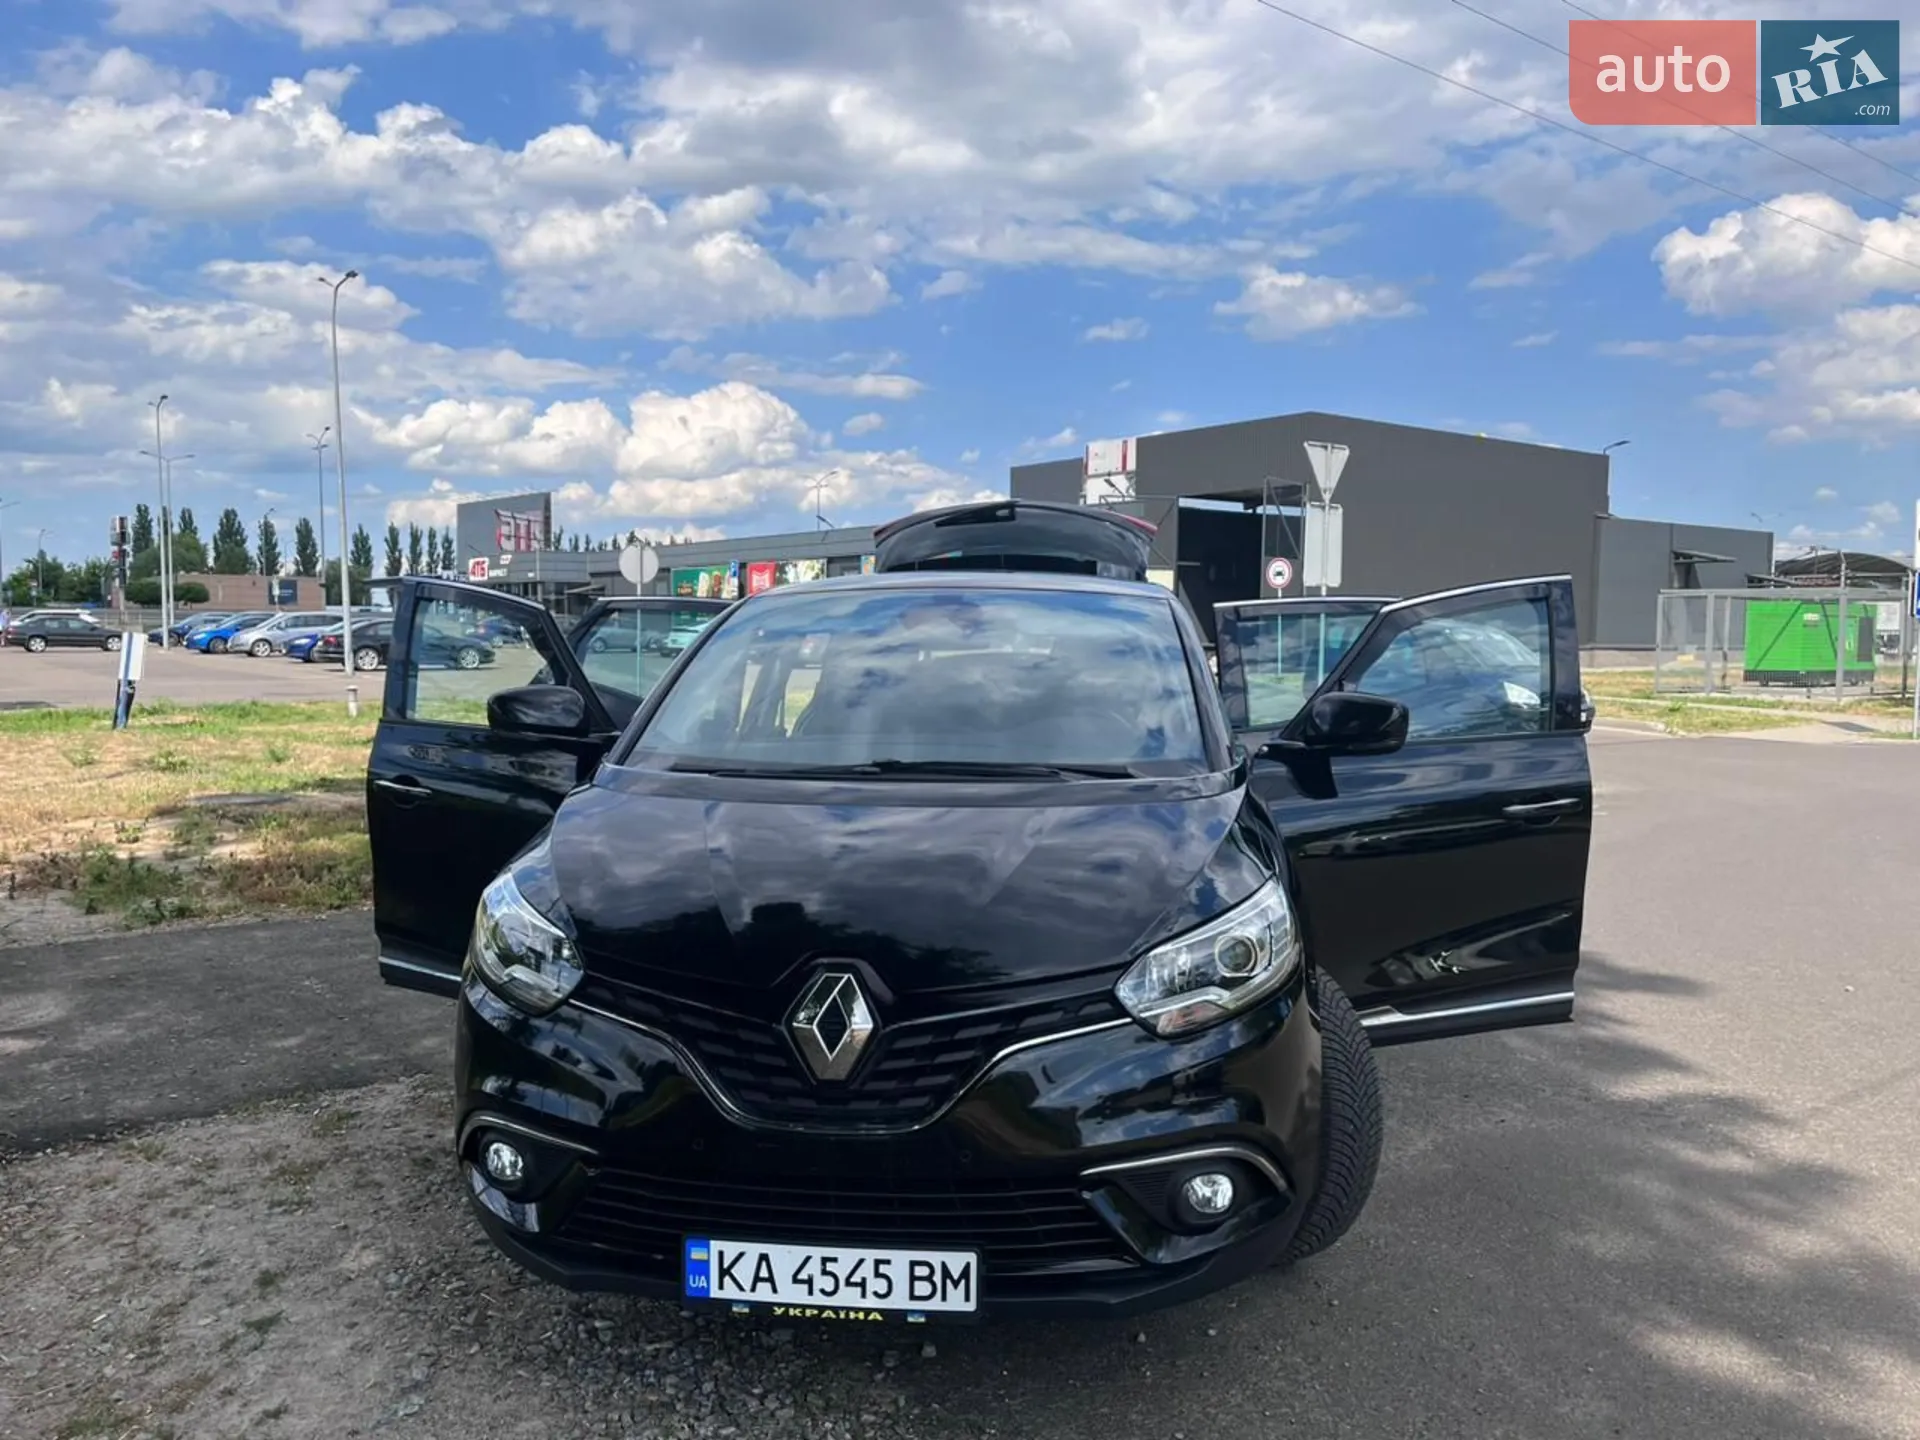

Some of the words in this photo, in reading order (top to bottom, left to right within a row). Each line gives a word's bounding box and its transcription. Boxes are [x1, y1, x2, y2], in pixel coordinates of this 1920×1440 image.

[689, 1275, 708, 1288] UA
[717, 1250, 779, 1294] KA
[791, 1255, 893, 1300] 4545
[908, 1259, 972, 1303] BM
[772, 1305, 884, 1321] УКРАЇНА
